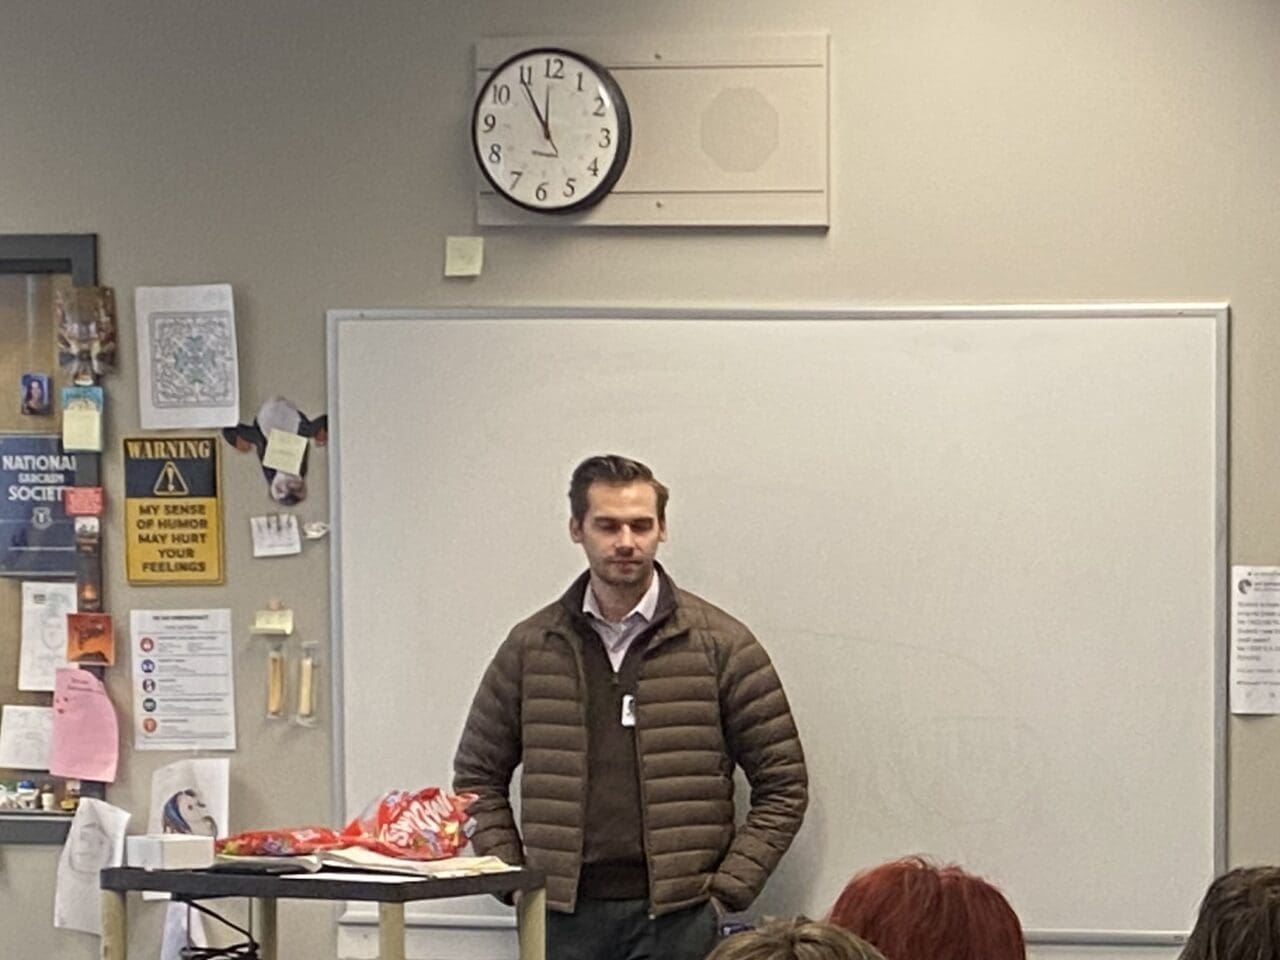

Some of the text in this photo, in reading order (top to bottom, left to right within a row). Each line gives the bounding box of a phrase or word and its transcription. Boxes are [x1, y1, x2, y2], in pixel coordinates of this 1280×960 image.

[520, 66, 533, 86] 11
[545, 58, 565, 79] 12
[576, 72, 584, 93] 1
[493, 84, 511, 105] 10
[592, 97, 606, 117] 2
[483, 114, 496, 134] 9
[598, 128, 611, 148] 3
[488, 143, 502, 164] 8
[587, 157, 599, 177] 4
[509, 171, 523, 190] 7
[563, 178, 577, 198] 5
[535, 182, 549, 201] 6
[127, 441, 211, 459] WARNING
[8, 485, 67, 501] SOCIET
[139, 505, 206, 515] MY SENSE
[136, 519, 208, 529] OF HUMOR
[138, 533, 207, 544] MAY HURT
[158, 548, 194, 558] YOUR
[142, 562, 206, 573] FEELINGS
